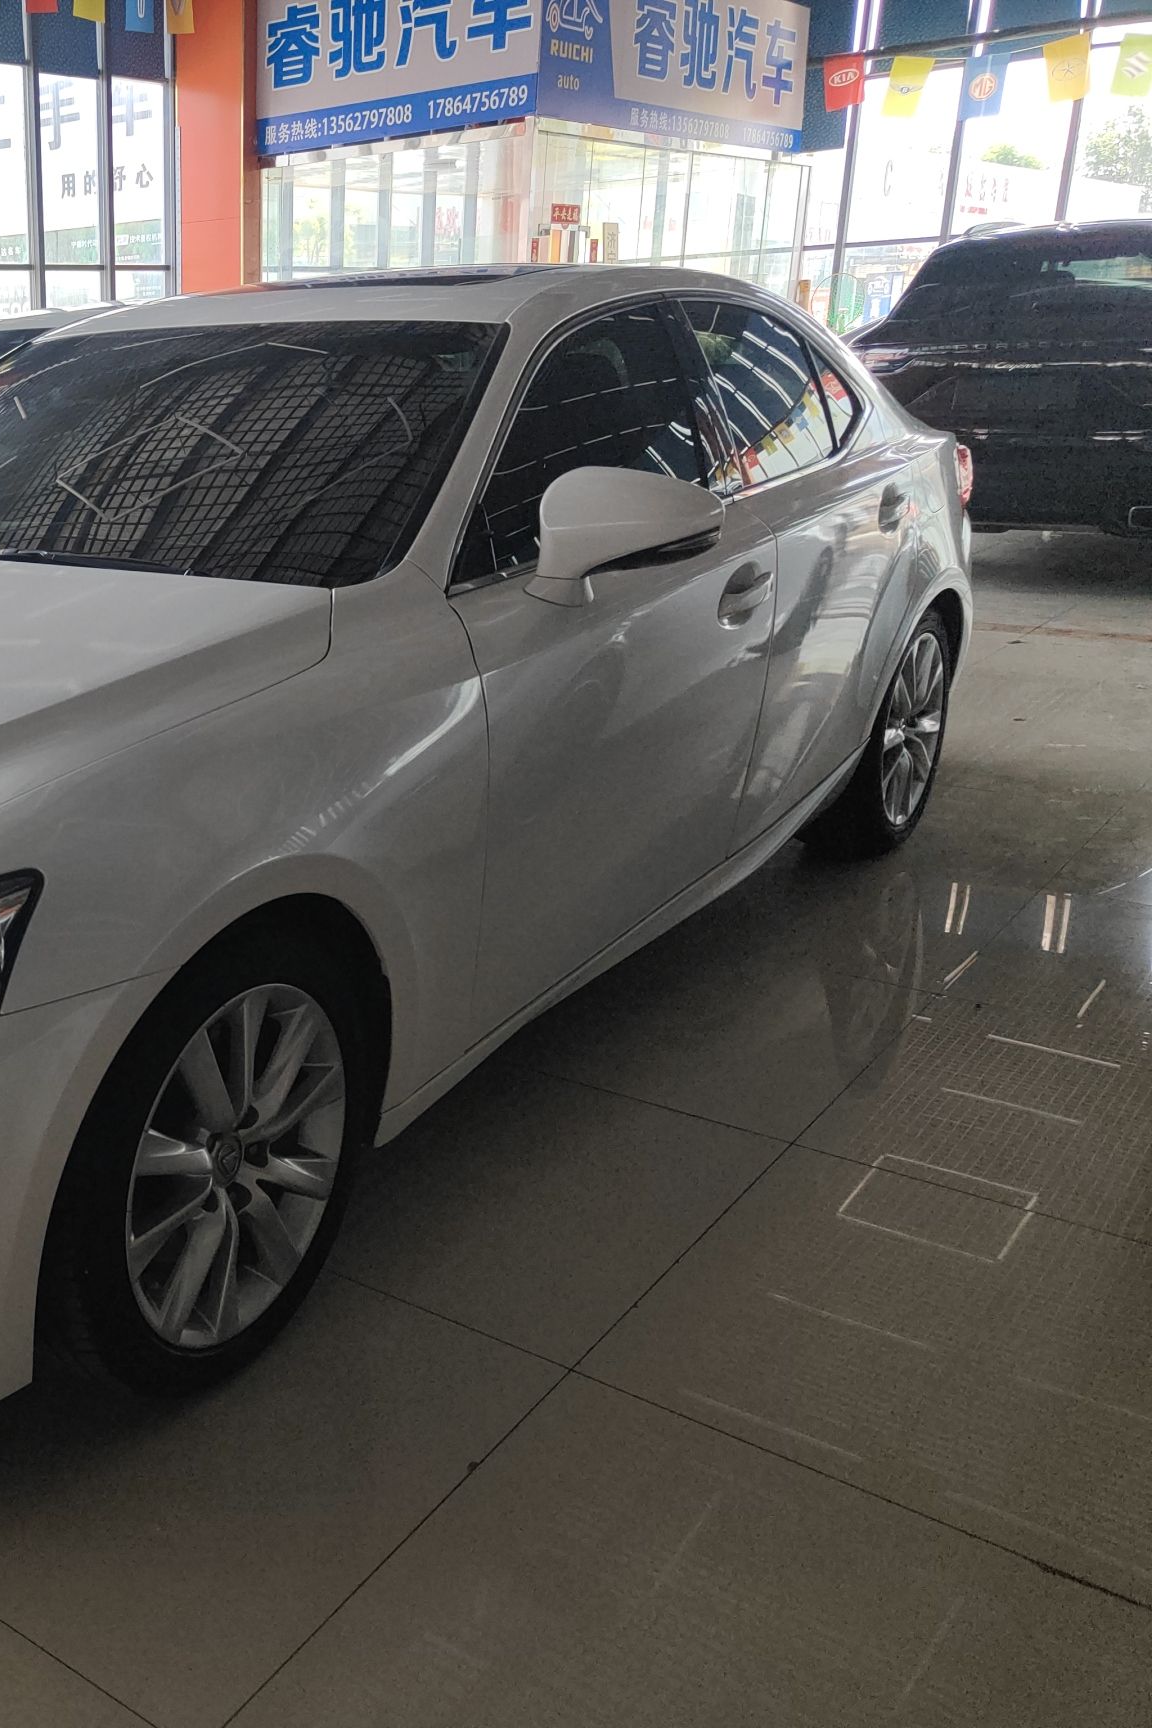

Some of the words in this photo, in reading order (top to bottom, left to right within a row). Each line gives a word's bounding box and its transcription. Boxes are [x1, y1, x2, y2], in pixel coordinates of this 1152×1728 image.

[266, 0, 533, 90] 睿驰汽车
[550, 38, 594, 64] RUICHI
[633, 0, 797, 106] 睿驰汽车
[557, 74, 580, 91] auto
[833, 69, 857, 86] KIA
[971, 76, 996, 99] MG
[265, 105, 412, 145] 服务热线:13562797808
[427, 85, 528, 119] 17864756789
[629, 107, 730, 140] 服务热线:13562797808
[742, 126, 794, 149] 17864756789
